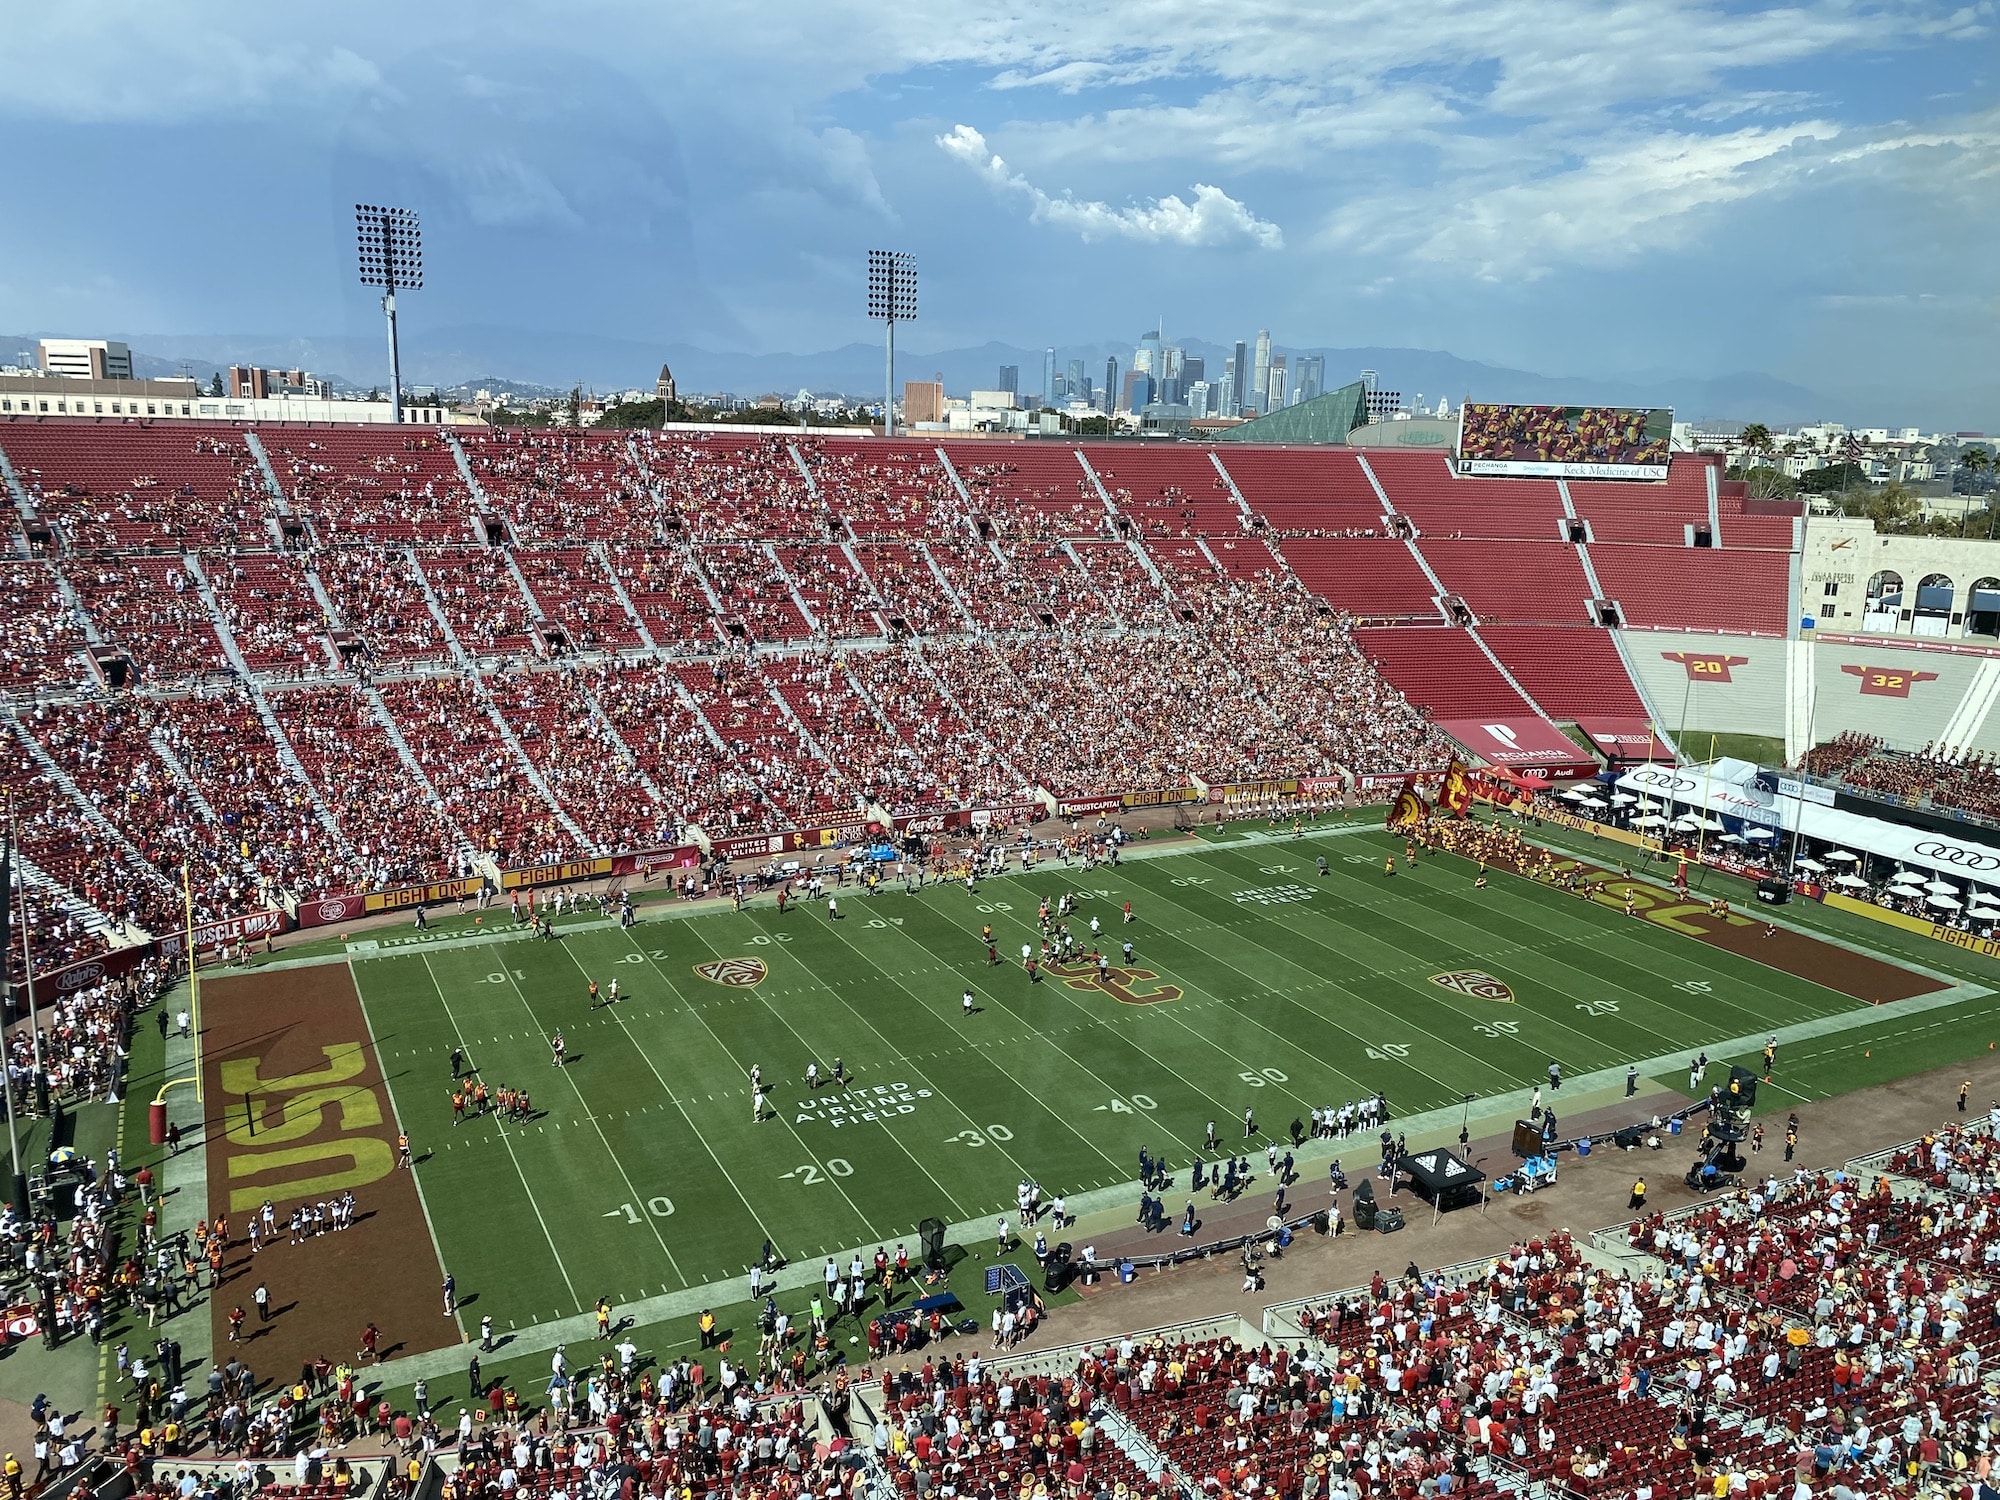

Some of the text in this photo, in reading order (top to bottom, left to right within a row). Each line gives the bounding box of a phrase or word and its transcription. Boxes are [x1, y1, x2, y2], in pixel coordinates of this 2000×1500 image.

[1564, 464, 1665, 478] Keck Medicine of USC
[1693, 661, 1722, 674] 20
[1871, 674, 1904, 688] 32
[1554, 768, 1574, 776] Audi
[1314, 781, 1339, 790] STONE
[1134, 790, 1186, 804] FIGHT ON!
[990, 808, 1012, 818] TURF
[838, 824, 866, 834] CREDIT
[838, 832, 864, 841] UNION
[724, 846, 767, 857] IRLINES
[730, 839, 766, 850] UNITED
[520, 861, 596, 884] FIGHT ON!
[383, 880, 466, 907] FIGHT ON!
[976, 902, 1014, 914] 50
[244, 912, 281, 935] MILK
[753, 932, 794, 946] 30
[1930, 926, 1980, 949] FIGHT
[626, 948, 670, 965] 20
[60, 966, 100, 989] Ralphs
[490, 969, 526, 984] 10
[1672, 980, 1712, 996] 10
[1574, 1000, 1620, 1016] 20
[1473, 1021, 1520, 1038] 30
[1364, 1042, 1409, 1062] 40
[1238, 1068, 1290, 1088] 50
[798, 1082, 909, 1110] UNITED
[796, 1088, 933, 1124] AIRLINES
[1110, 1094, 1158, 1116] 40
[830, 1104, 916, 1128] FIELD
[220, 1041, 395, 1213] USC
[958, 1124, 1015, 1148] 30
[795, 1158, 855, 1186] 20
[620, 1196, 676, 1225] 10
[477, 1411, 484, 1420] G
